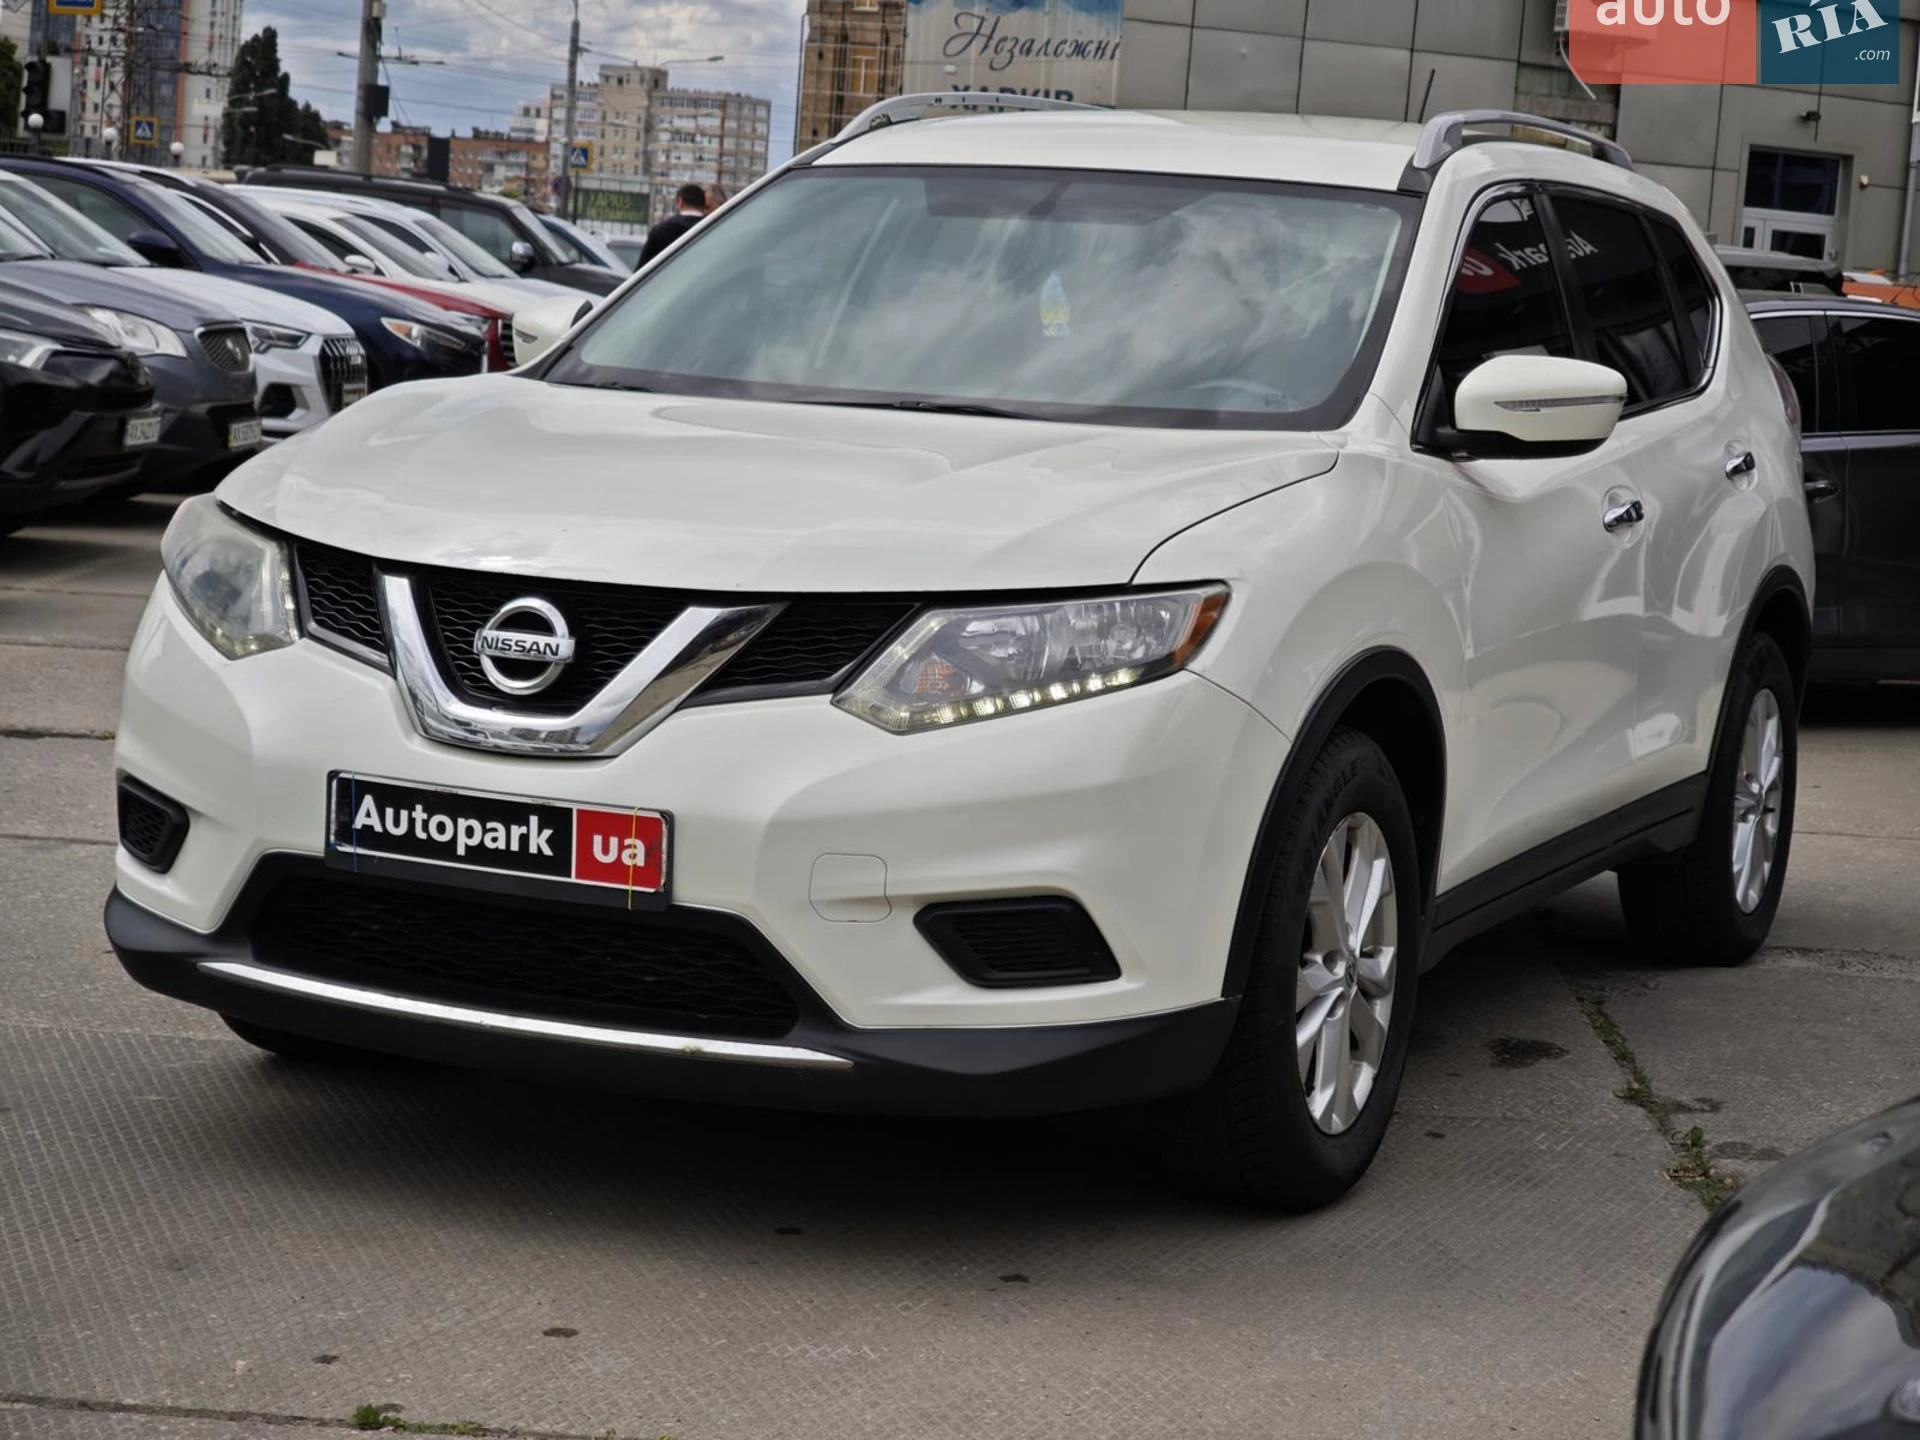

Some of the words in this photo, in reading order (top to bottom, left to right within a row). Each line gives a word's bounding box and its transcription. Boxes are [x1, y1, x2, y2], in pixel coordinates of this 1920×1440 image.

[481, 635, 560, 657] NISSAN
[352, 794, 554, 857] Autopark
[592, 833, 647, 868] ua
